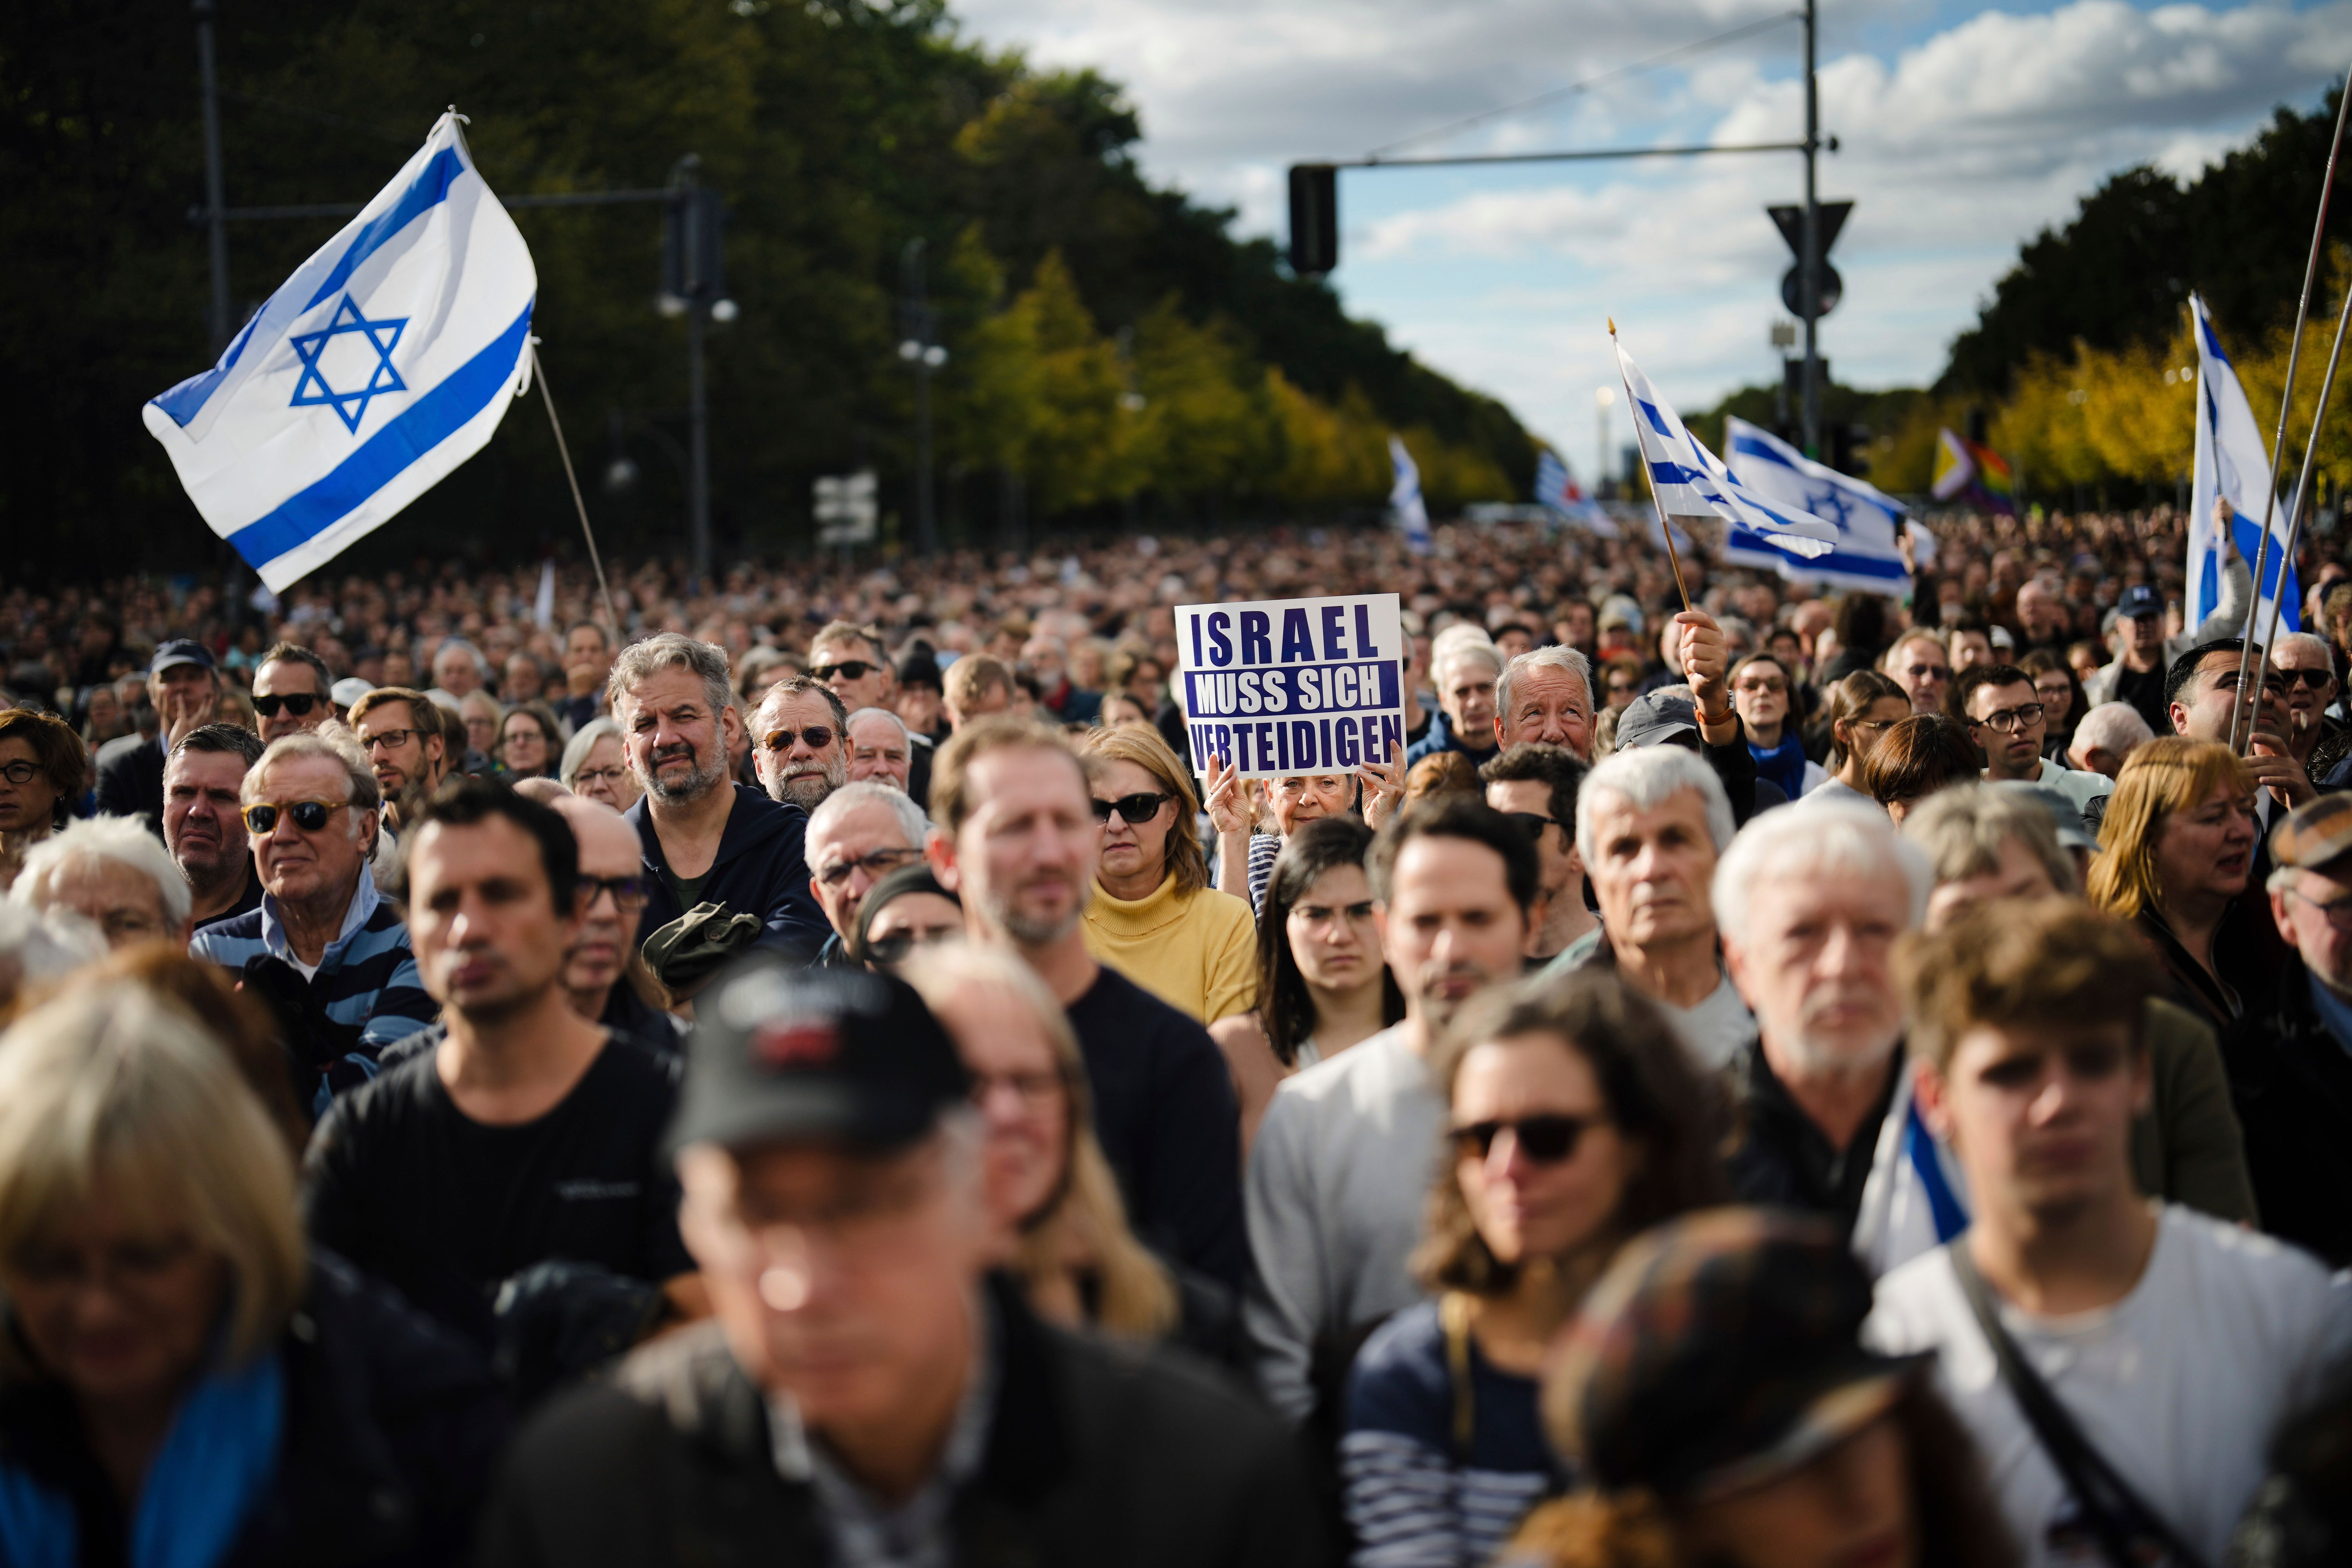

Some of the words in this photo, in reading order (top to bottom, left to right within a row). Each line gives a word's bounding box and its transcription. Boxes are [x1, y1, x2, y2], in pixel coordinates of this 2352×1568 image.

[1191, 604, 1378, 667] ISRAEL
[1195, 671, 1288, 714] MUSS
[1298, 665, 1381, 710] SICH
[1190, 715, 1402, 771] VERTEIDIGEN
